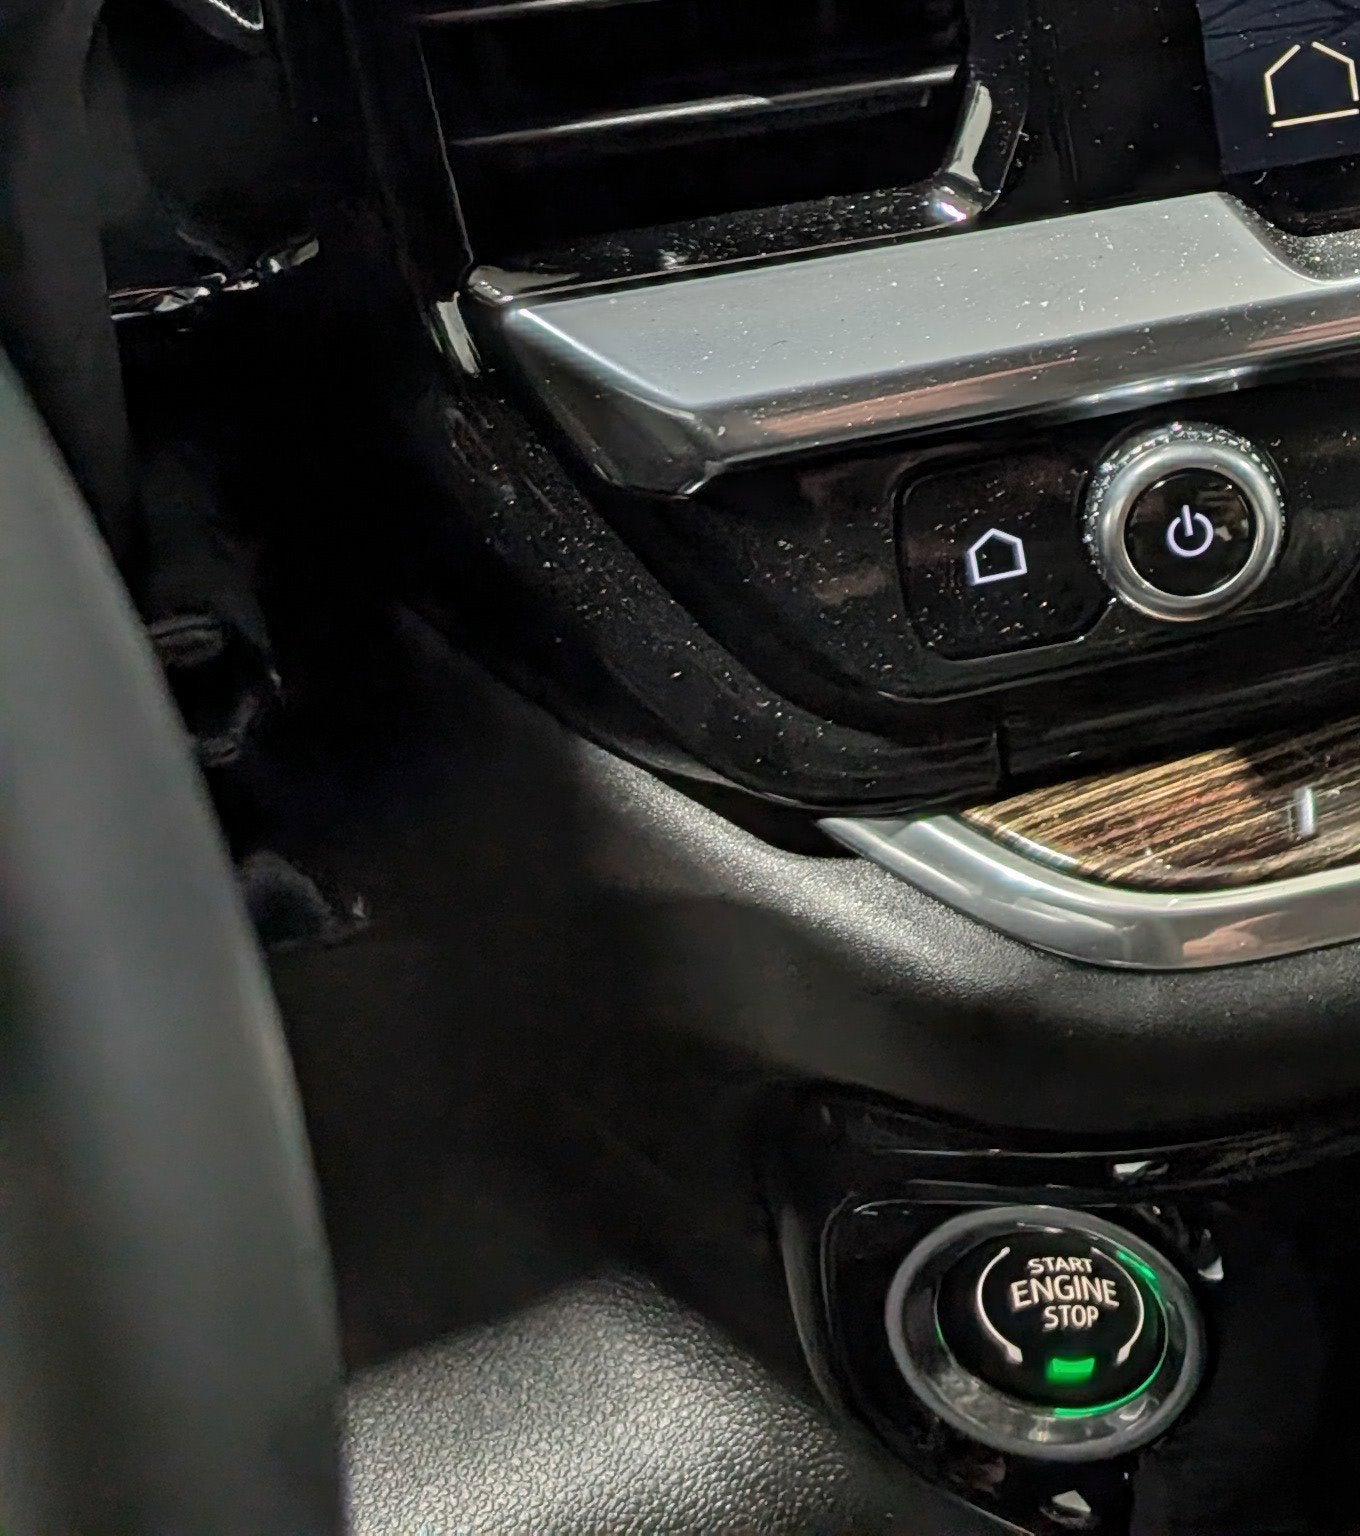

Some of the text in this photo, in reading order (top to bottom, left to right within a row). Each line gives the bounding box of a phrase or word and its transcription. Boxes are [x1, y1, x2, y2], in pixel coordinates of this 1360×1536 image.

[1027, 1256, 1094, 1275] START
[1010, 1275, 1120, 1308] ENGINE
[1042, 1302, 1100, 1331] STOP
